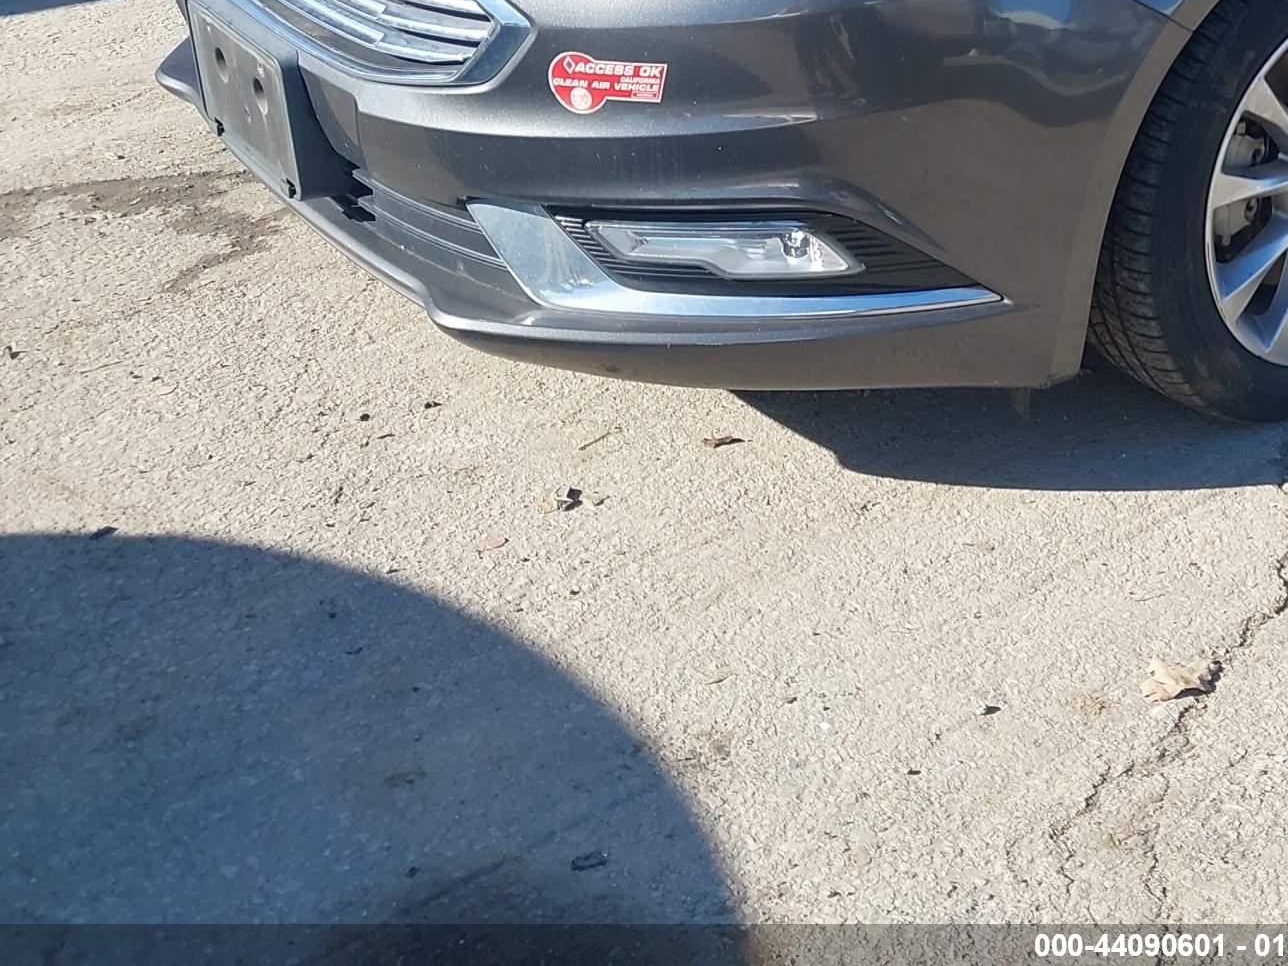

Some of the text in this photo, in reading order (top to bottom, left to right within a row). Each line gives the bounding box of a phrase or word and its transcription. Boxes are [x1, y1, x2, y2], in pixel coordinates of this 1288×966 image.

[575, 62, 663, 77] ACCESS OK
[552, 77, 660, 92] CLEAN AIR VEHICLE
[620, 76, 661, 84] CALIFORNIA
